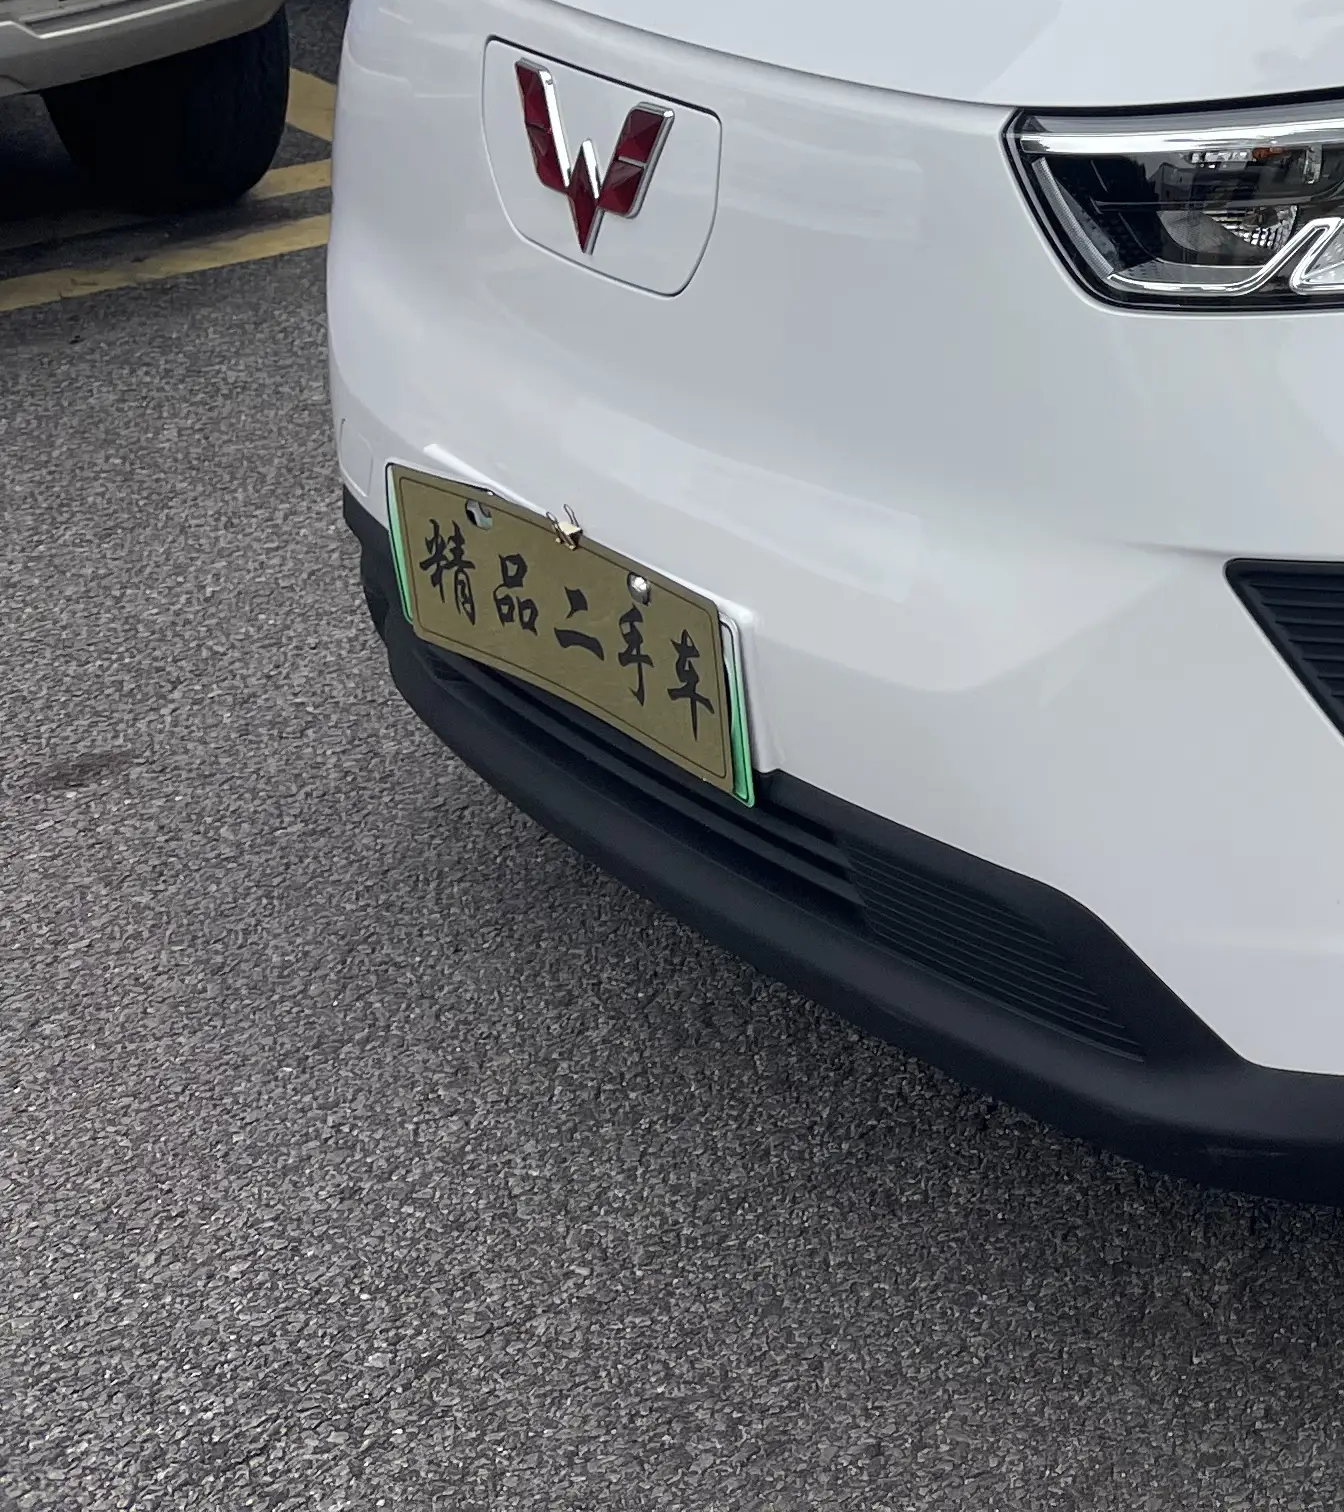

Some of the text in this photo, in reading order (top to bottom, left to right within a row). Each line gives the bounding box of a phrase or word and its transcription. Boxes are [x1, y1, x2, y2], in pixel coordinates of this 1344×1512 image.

[419, 518, 715, 741] 精品二手车
